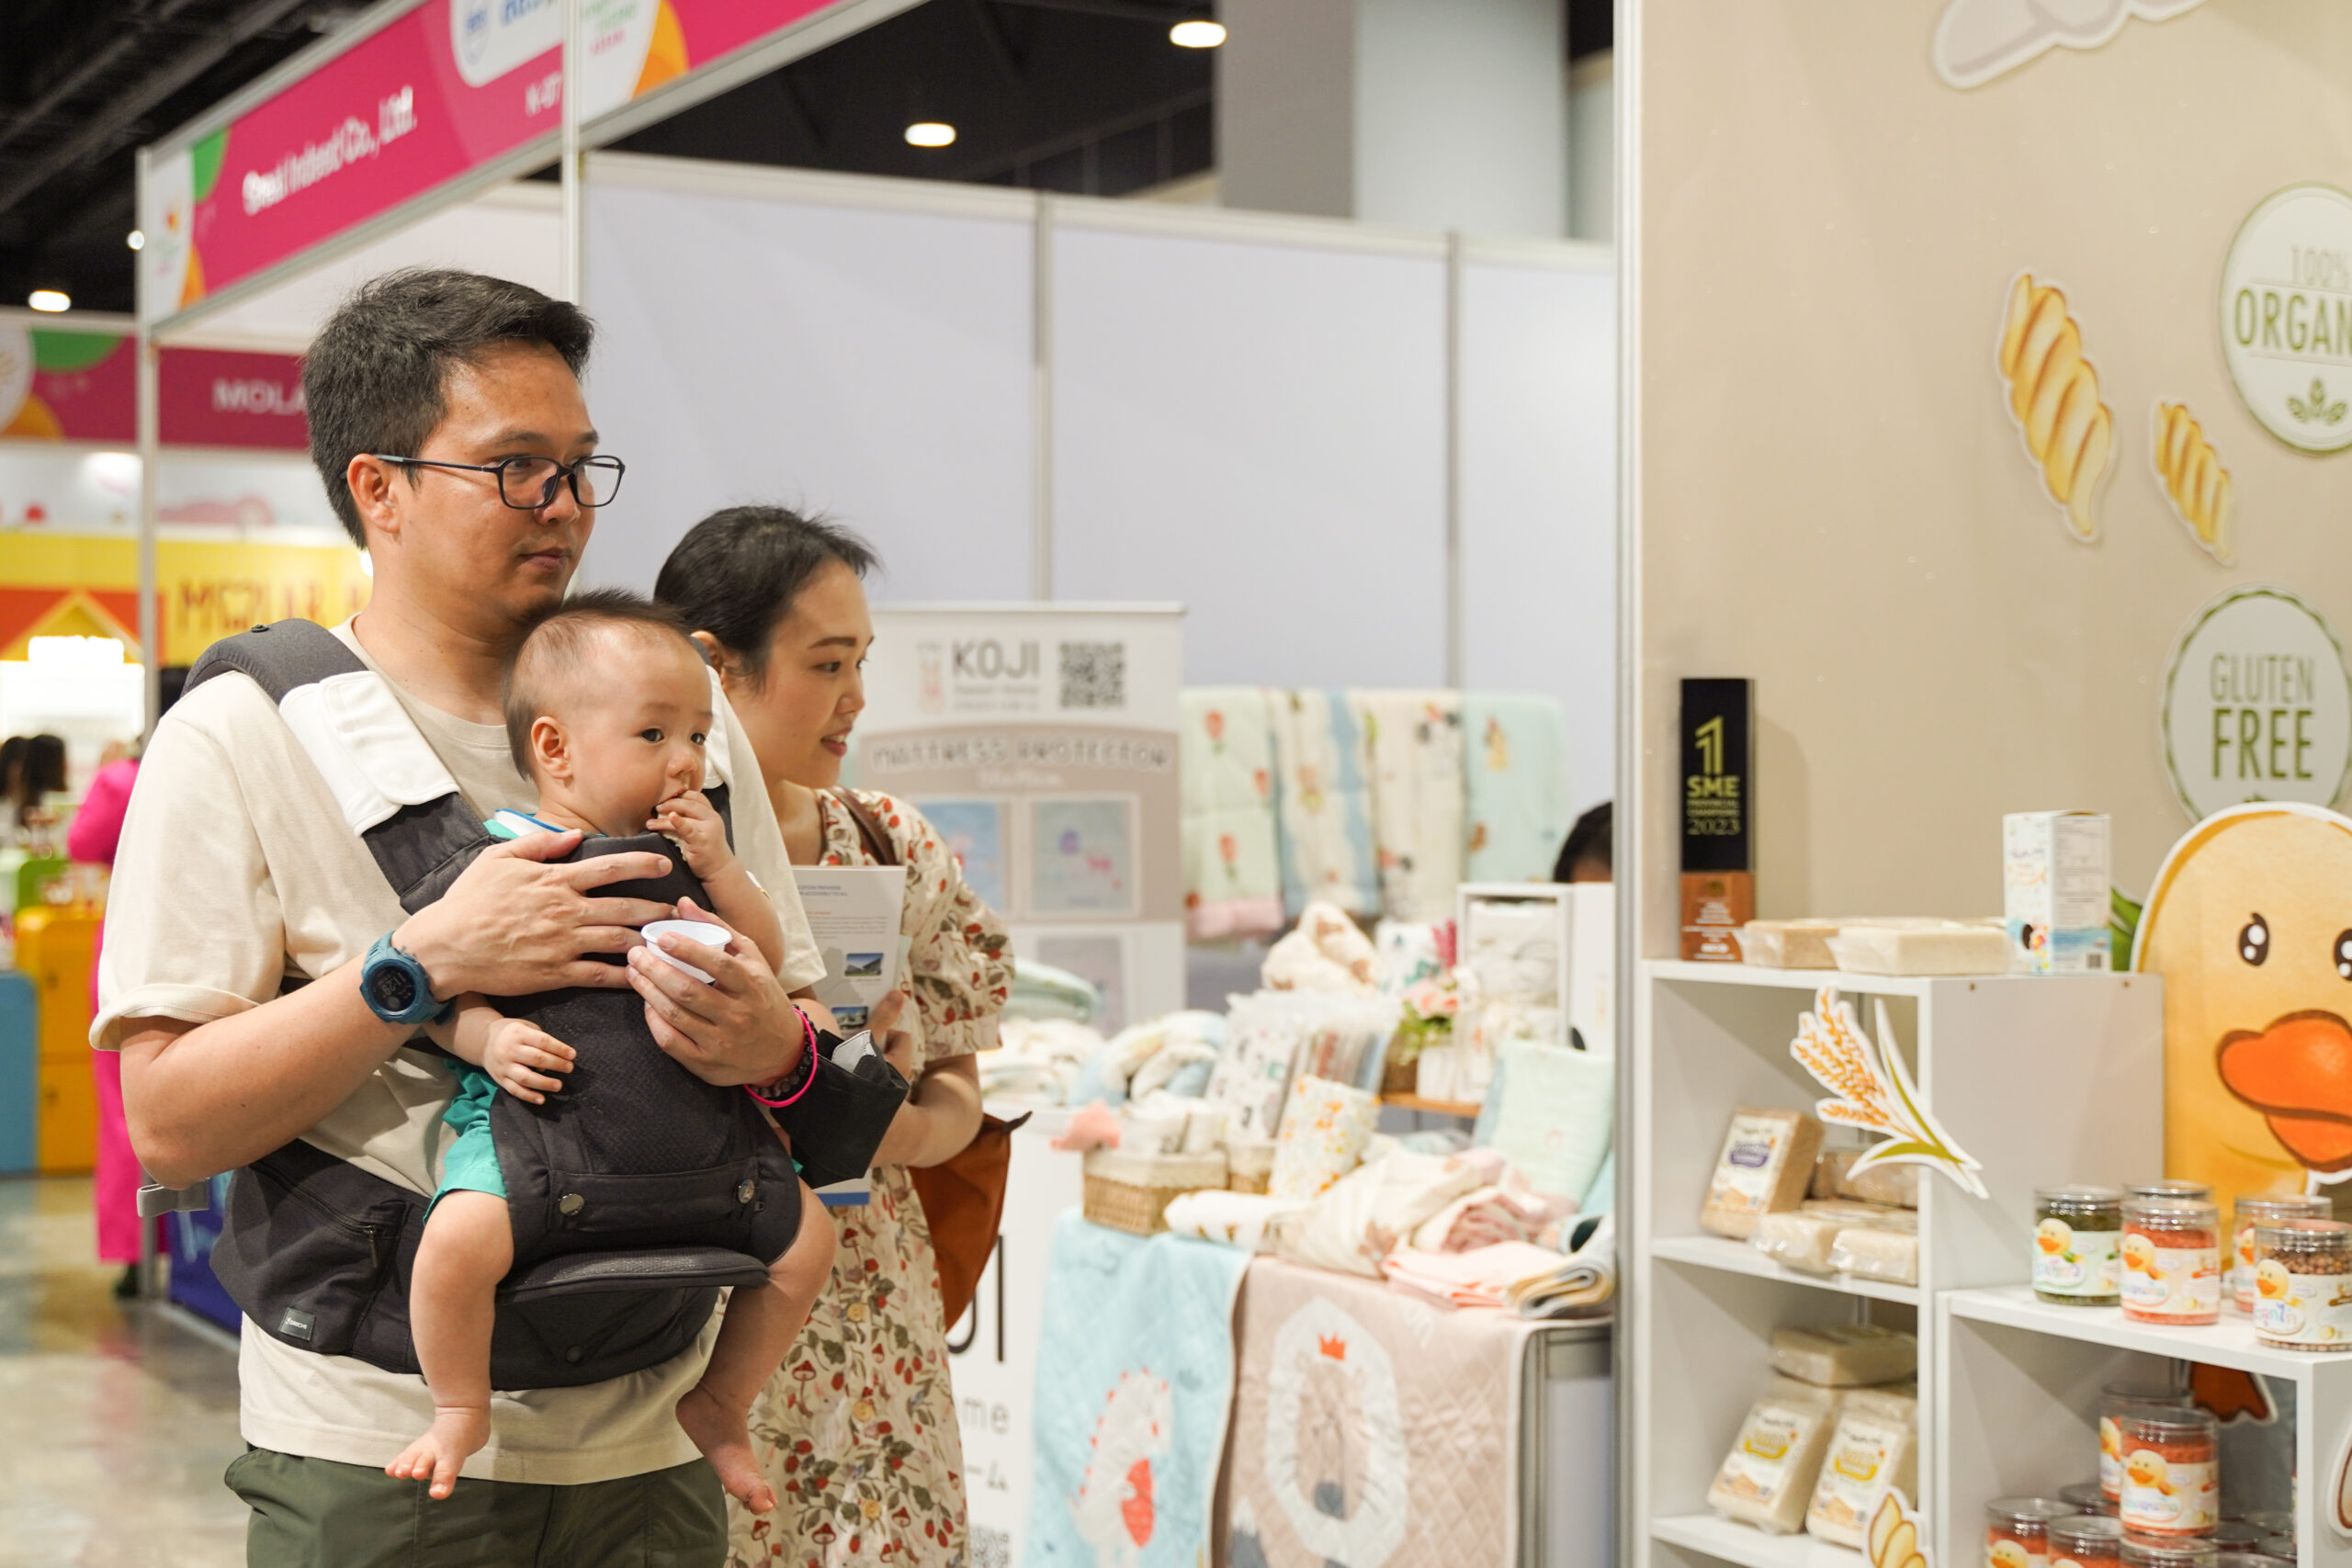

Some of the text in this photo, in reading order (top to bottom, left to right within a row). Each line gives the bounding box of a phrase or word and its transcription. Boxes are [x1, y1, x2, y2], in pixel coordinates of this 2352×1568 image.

[950, 639, 1041, 679] KOJI
[2210, 653, 2314, 704] GLUTEN
[2211, 707, 2314, 780] FREE
[1687, 775, 1740, 798] SME
[1687, 818, 1741, 835] 2023
